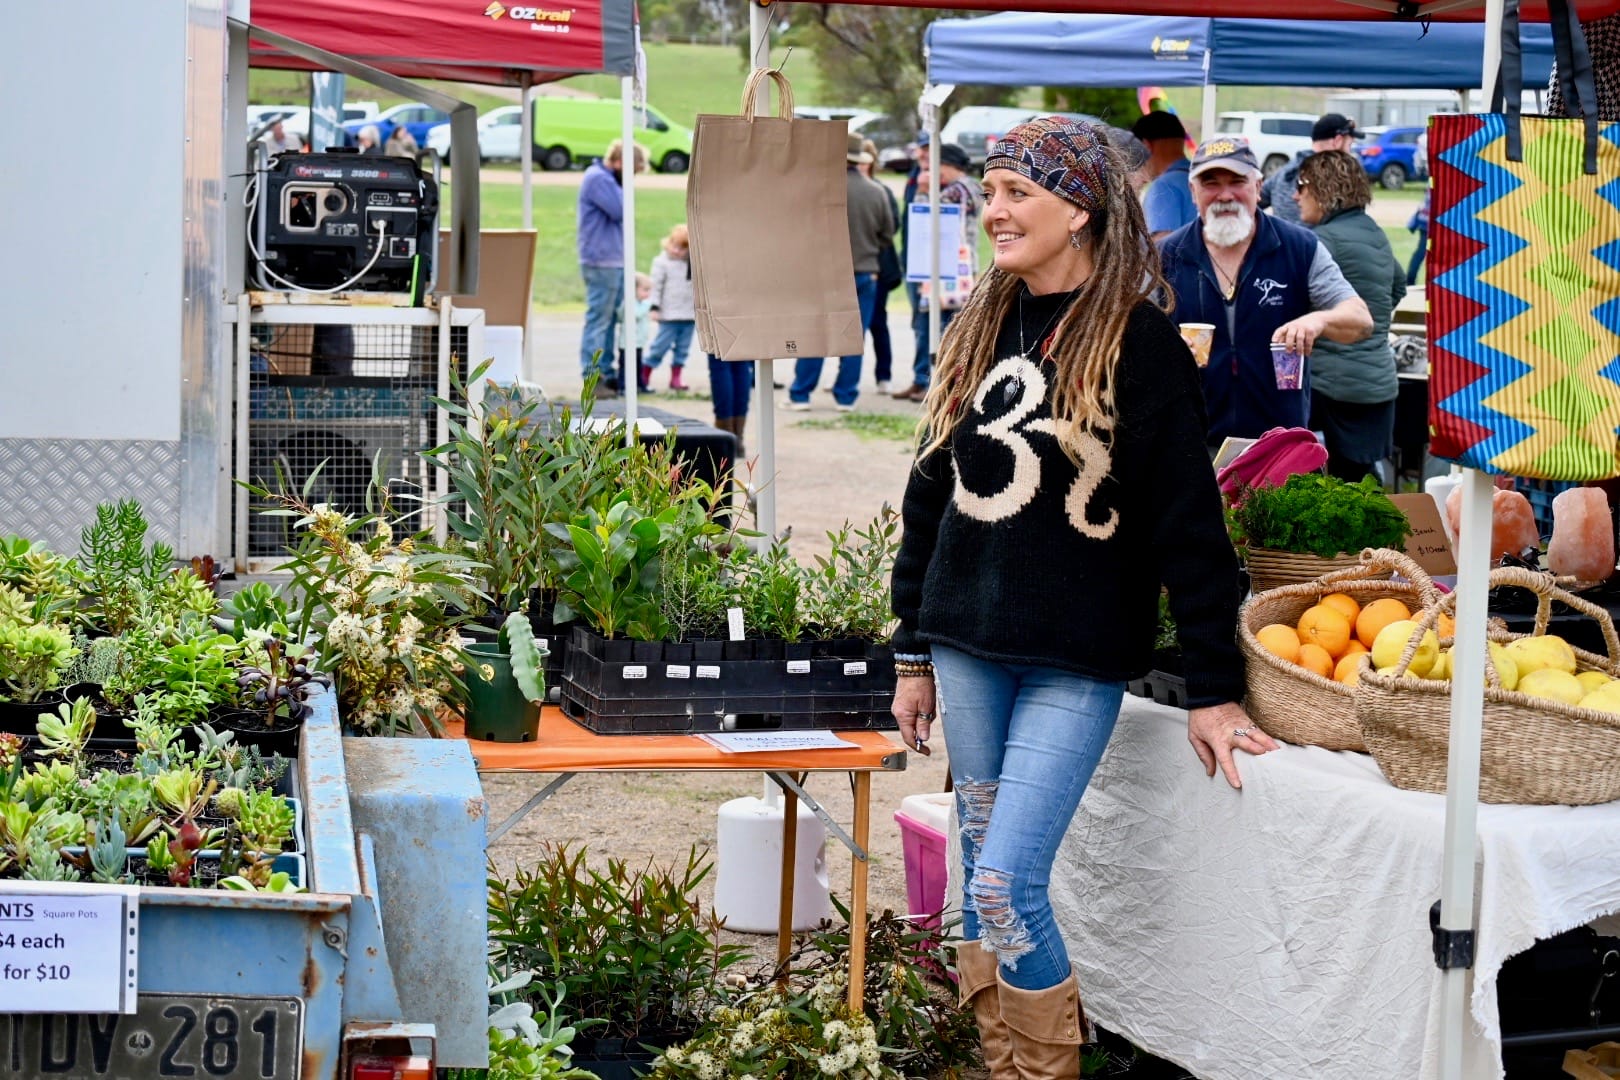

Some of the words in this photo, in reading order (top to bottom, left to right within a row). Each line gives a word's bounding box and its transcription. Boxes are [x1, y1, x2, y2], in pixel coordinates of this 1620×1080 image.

[43, 910, 76, 919] Square
[78, 910, 98, 919] Pots
[22, 933, 65, 949] each
[4, 964, 31, 980] for
[36, 963, 71, 982] $10
